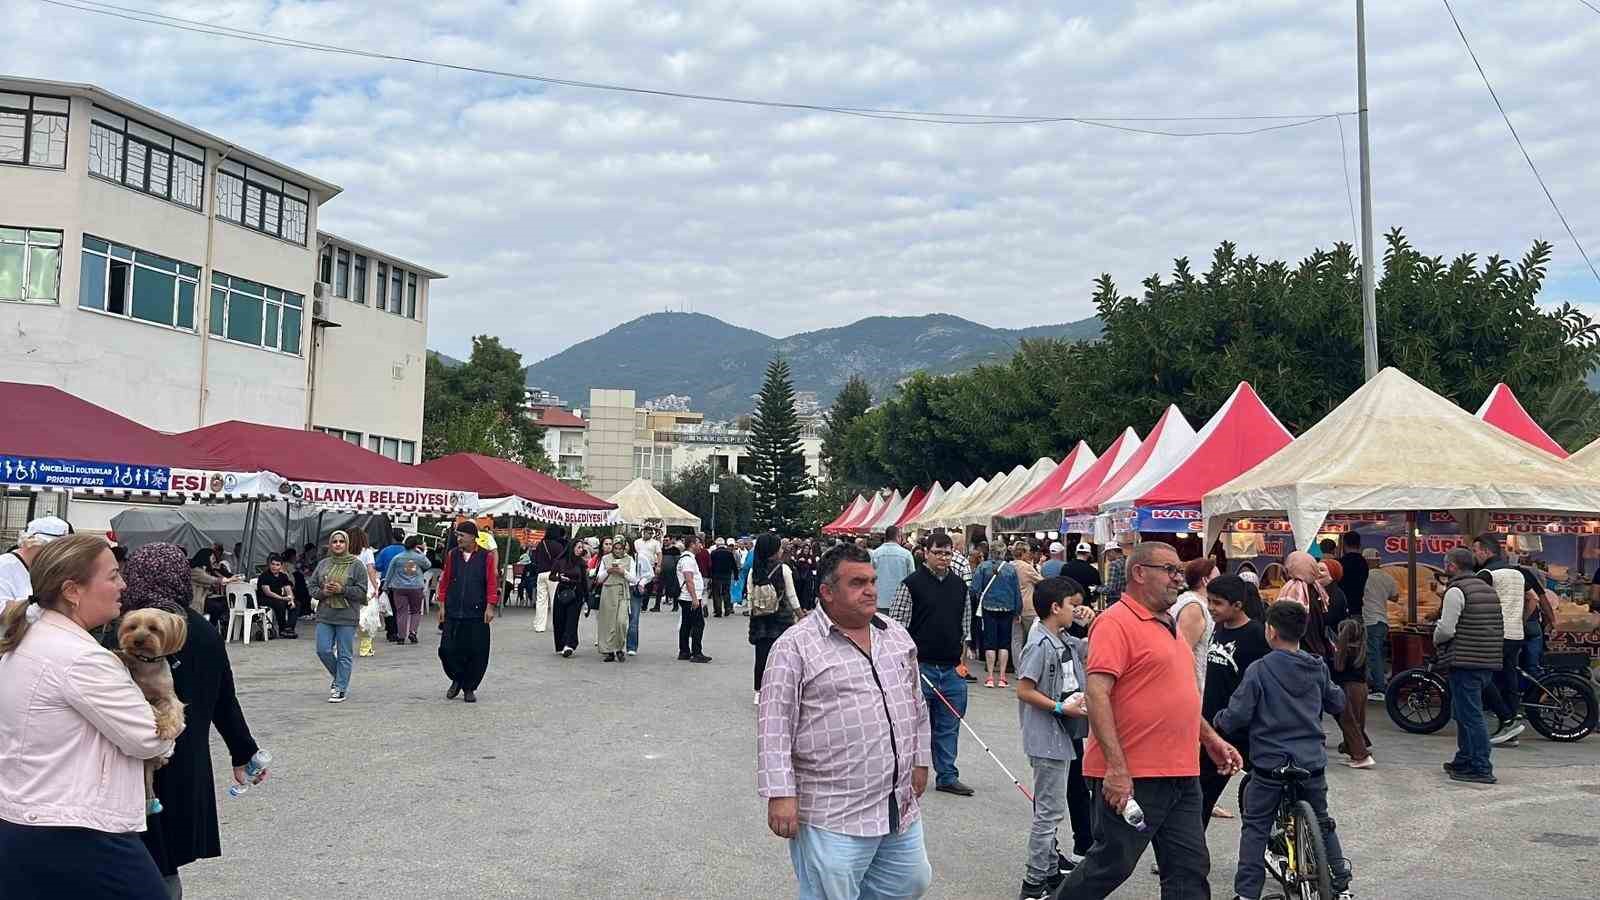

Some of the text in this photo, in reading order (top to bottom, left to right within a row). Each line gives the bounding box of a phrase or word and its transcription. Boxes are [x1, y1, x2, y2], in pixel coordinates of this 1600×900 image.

[40, 464, 113, 475] ÖNCELİKLİ KOLTUKLAR
[46, 475, 104, 486] PRIORITY SEATS
[303, 487, 448, 506] ALANYA BELEDİYESİ
[532, 506, 603, 523] ALANYA BELEDİYESİ
[1151, 509, 1203, 519] KAR
